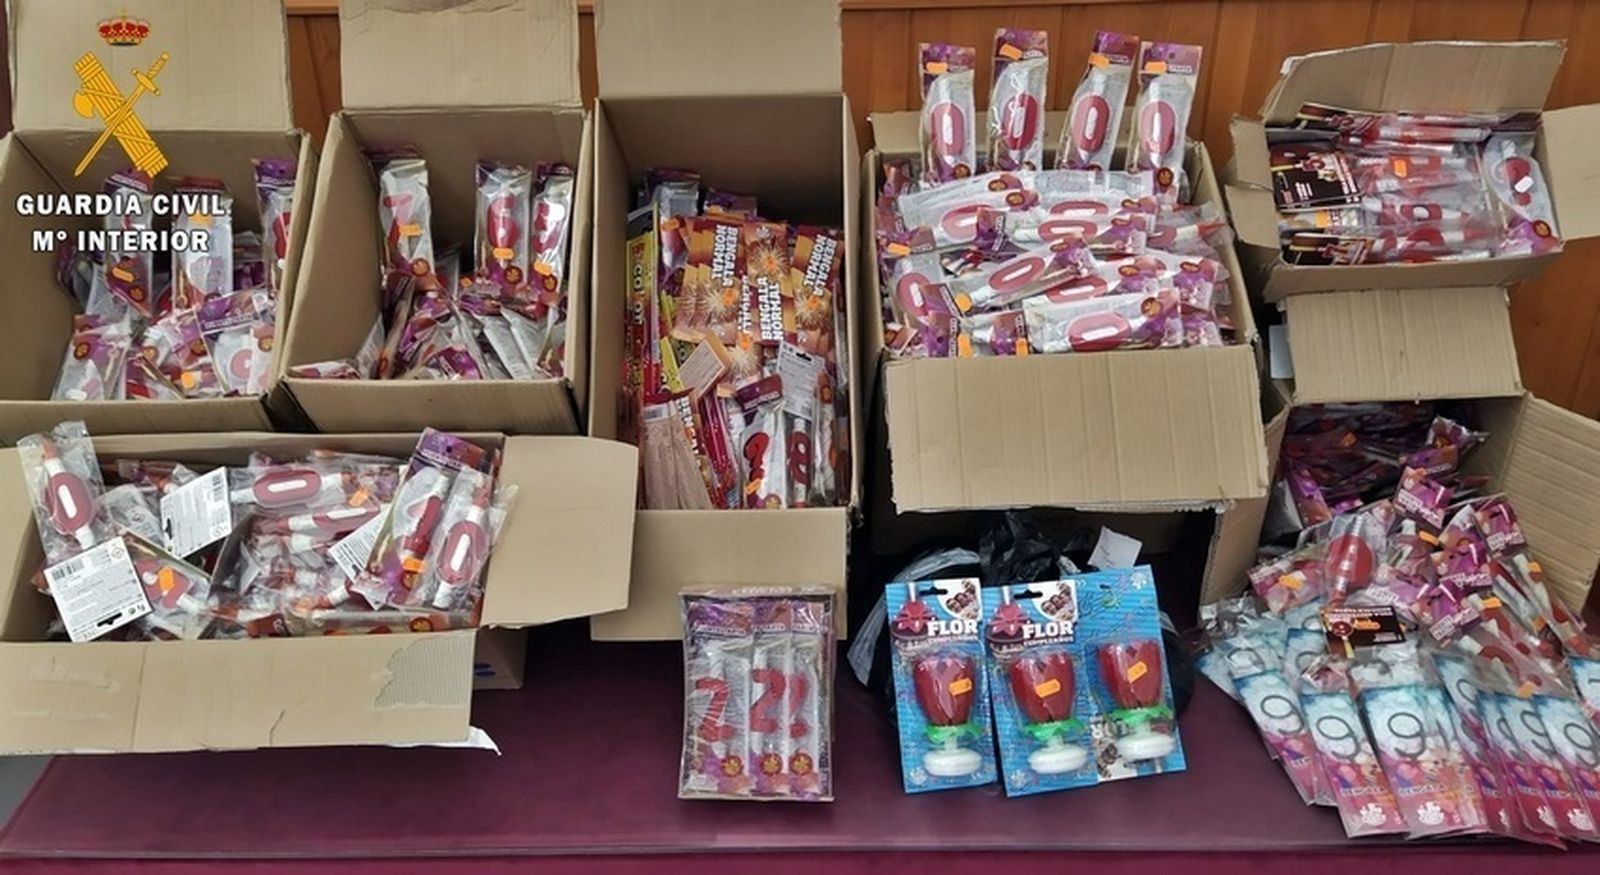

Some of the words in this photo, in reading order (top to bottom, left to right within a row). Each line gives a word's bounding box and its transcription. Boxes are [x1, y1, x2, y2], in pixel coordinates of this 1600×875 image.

[711, 224, 728, 279] NORMAL
[722, 226, 738, 287] BENGALA
[803, 234, 827, 287] NORMAL
[813, 238, 837, 296] BENGALA
[757, 276, 773, 340] BENGALA
[769, 283, 784, 340] NORMAL
[927, 618, 979, 636] FLOR
[1022, 620, 1074, 638] FLOR
